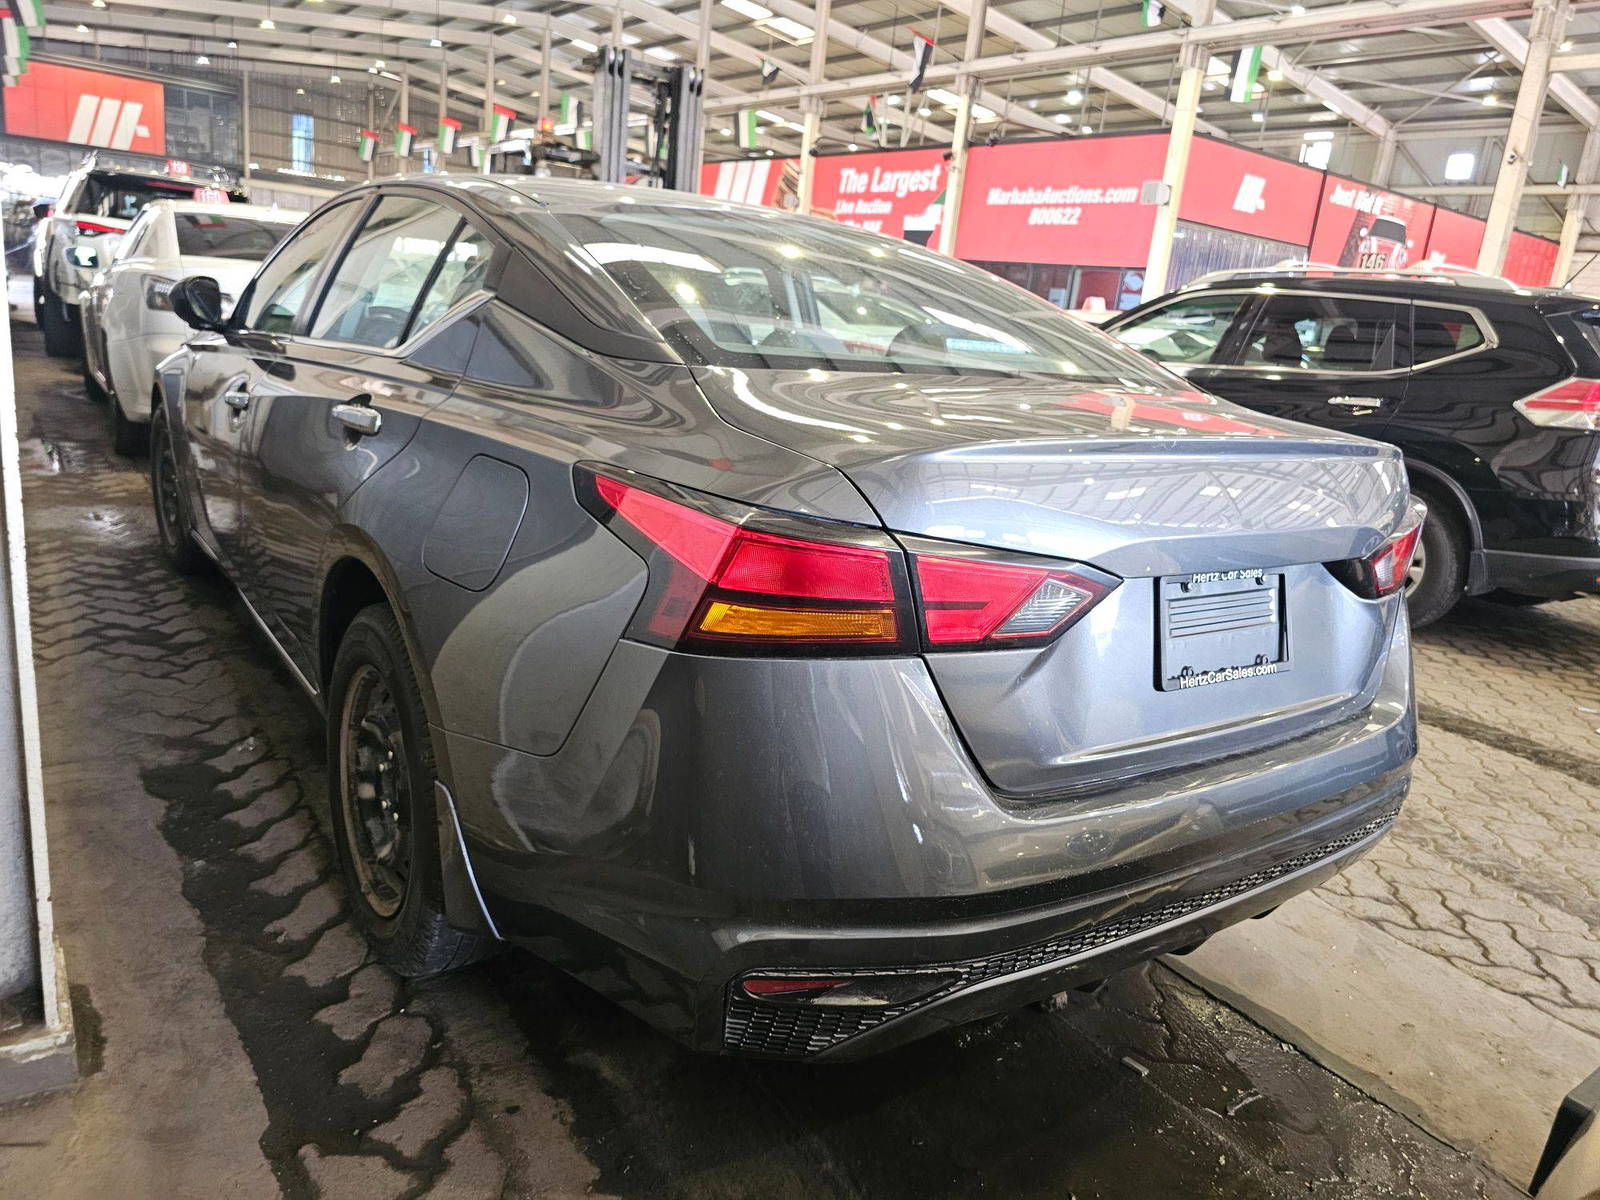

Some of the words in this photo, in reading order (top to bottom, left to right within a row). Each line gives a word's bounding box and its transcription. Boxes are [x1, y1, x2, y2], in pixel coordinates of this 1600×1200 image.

[839, 168, 868, 193] The
[871, 164, 940, 197] Largest
[987, 186, 1138, 204] MarhabaAuctions.com
[855, 199, 892, 214] Auction
[1029, 208, 1081, 225] 800622
[1361, 253, 1385, 269] 146
[1193, 571, 1220, 583] Hertz
[1221, 570, 1240, 581] Car
[1241, 568, 1263, 579] Sales
[1180, 663, 1277, 689] HertzCarSales.com
